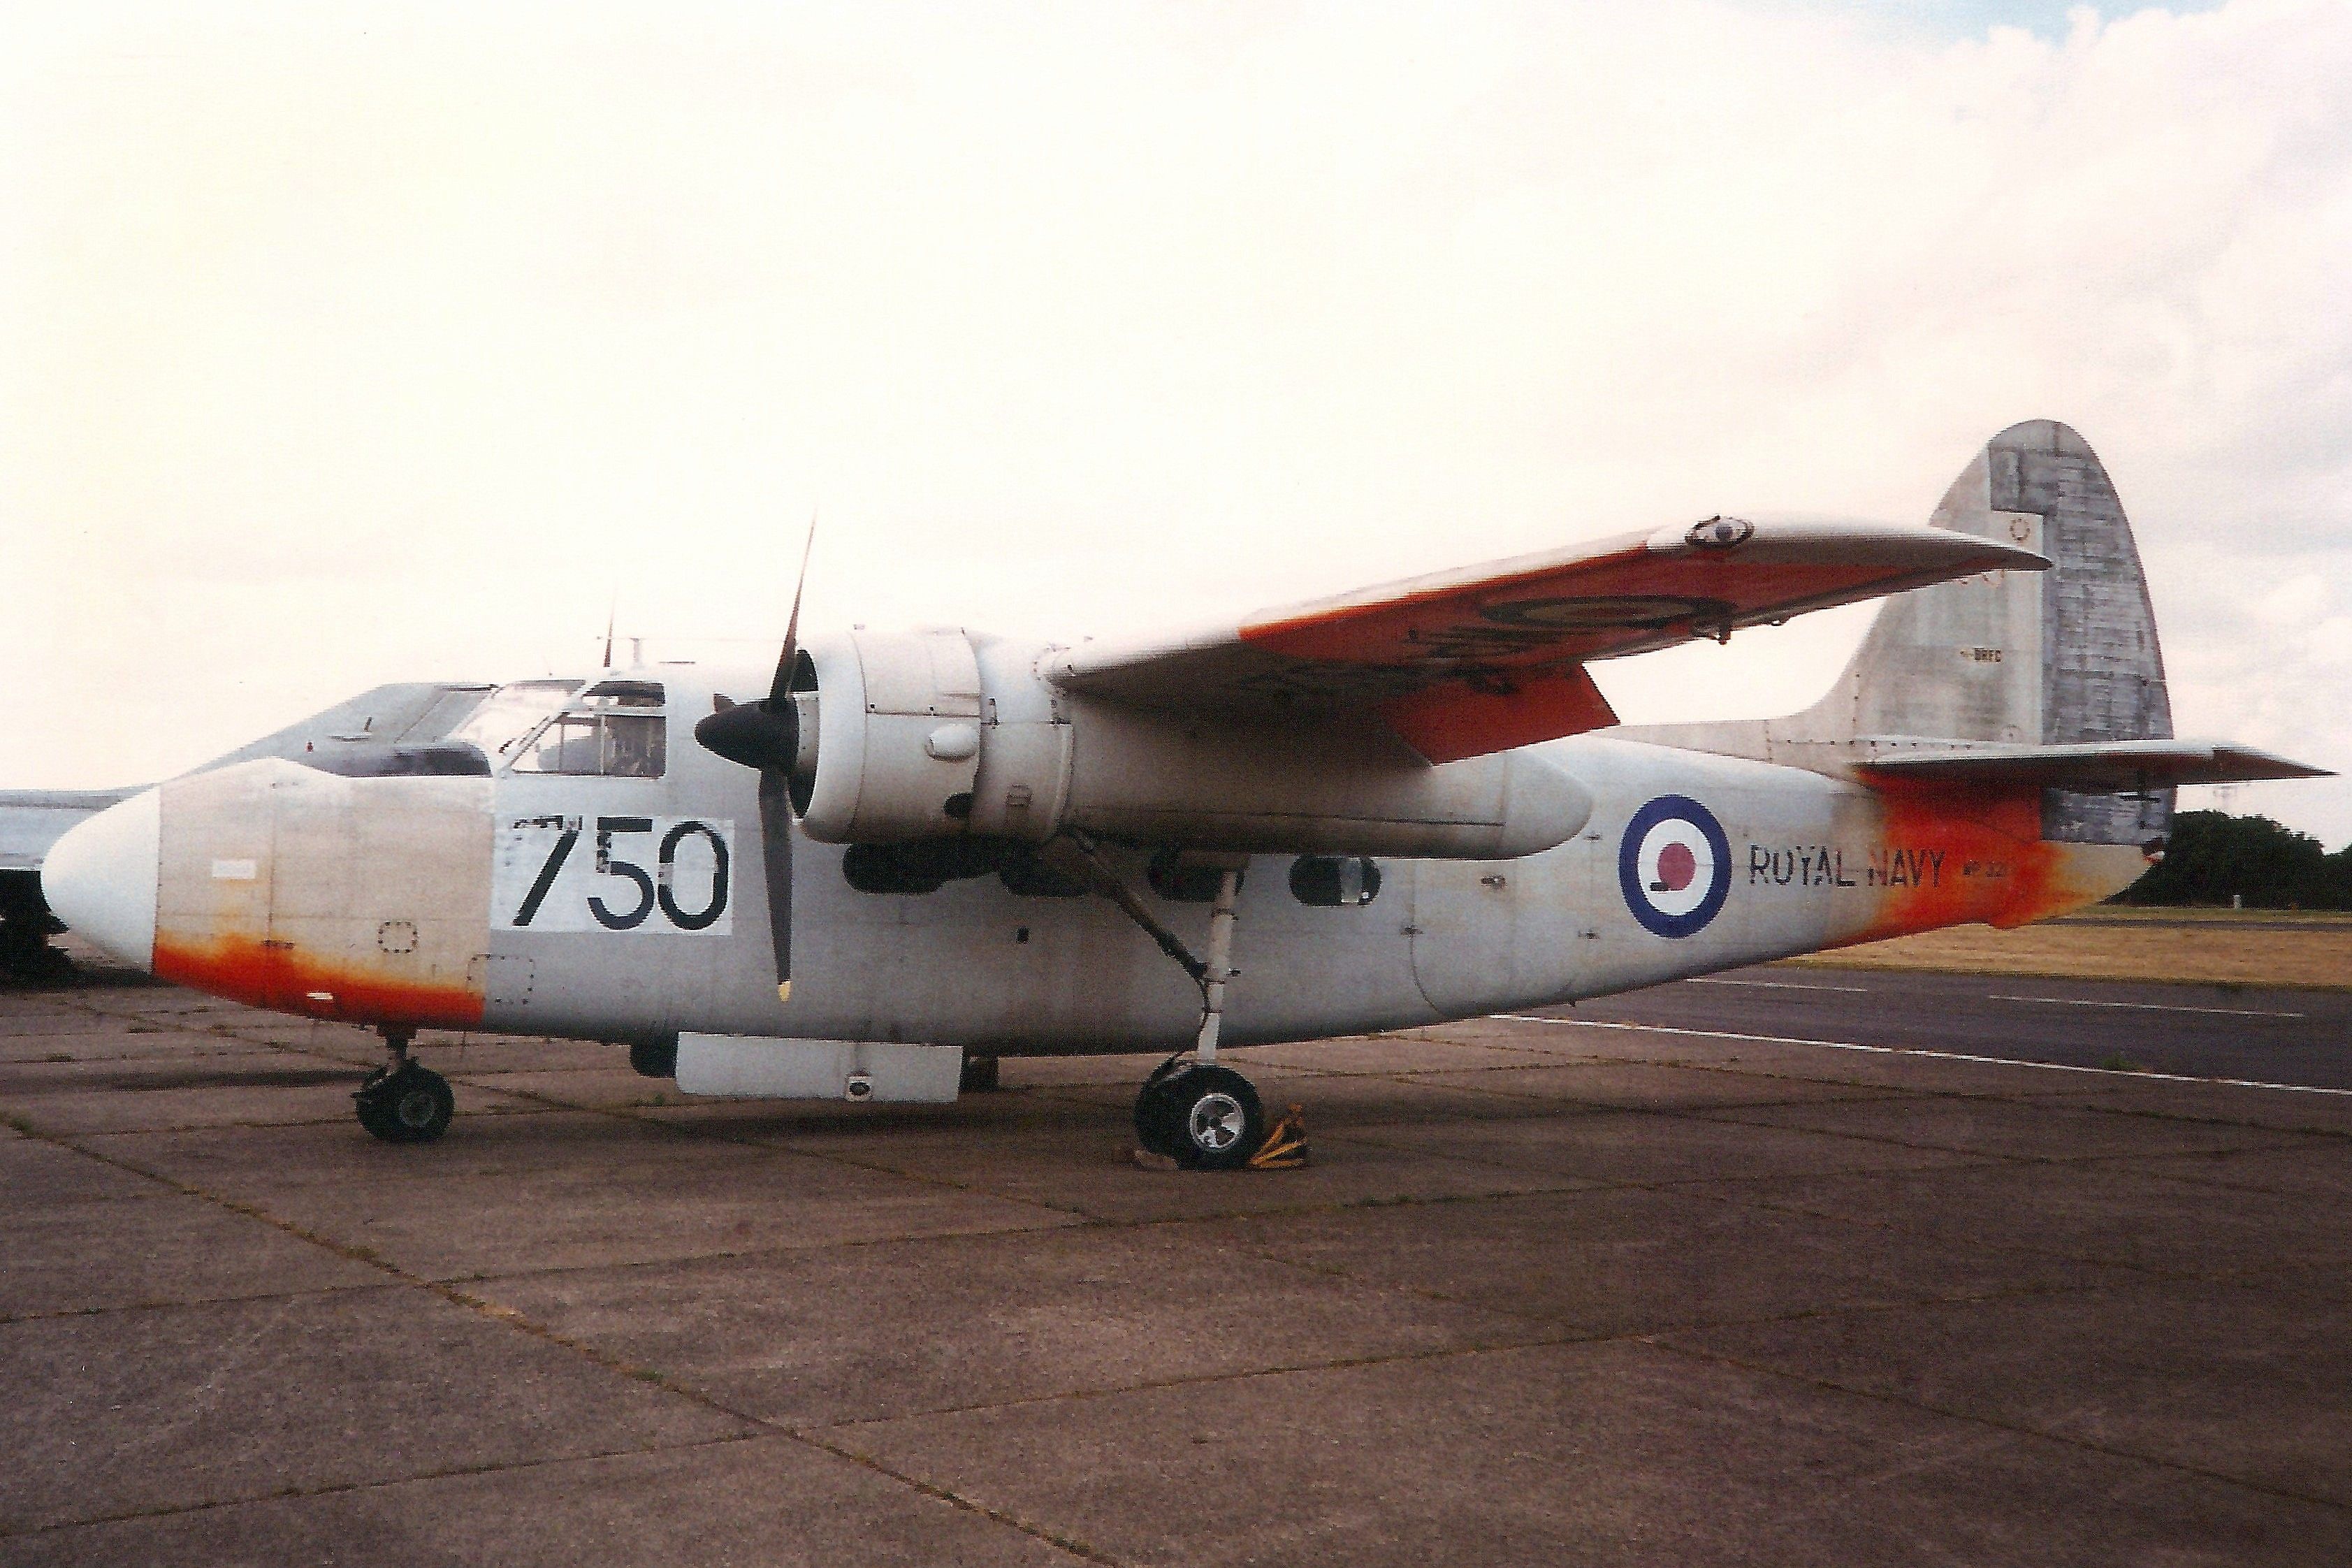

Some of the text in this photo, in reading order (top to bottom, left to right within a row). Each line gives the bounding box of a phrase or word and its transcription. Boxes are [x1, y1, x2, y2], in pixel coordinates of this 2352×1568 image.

[512, 815, 729, 930] 750
[1750, 844, 1945, 887] ROYAL NAVY
